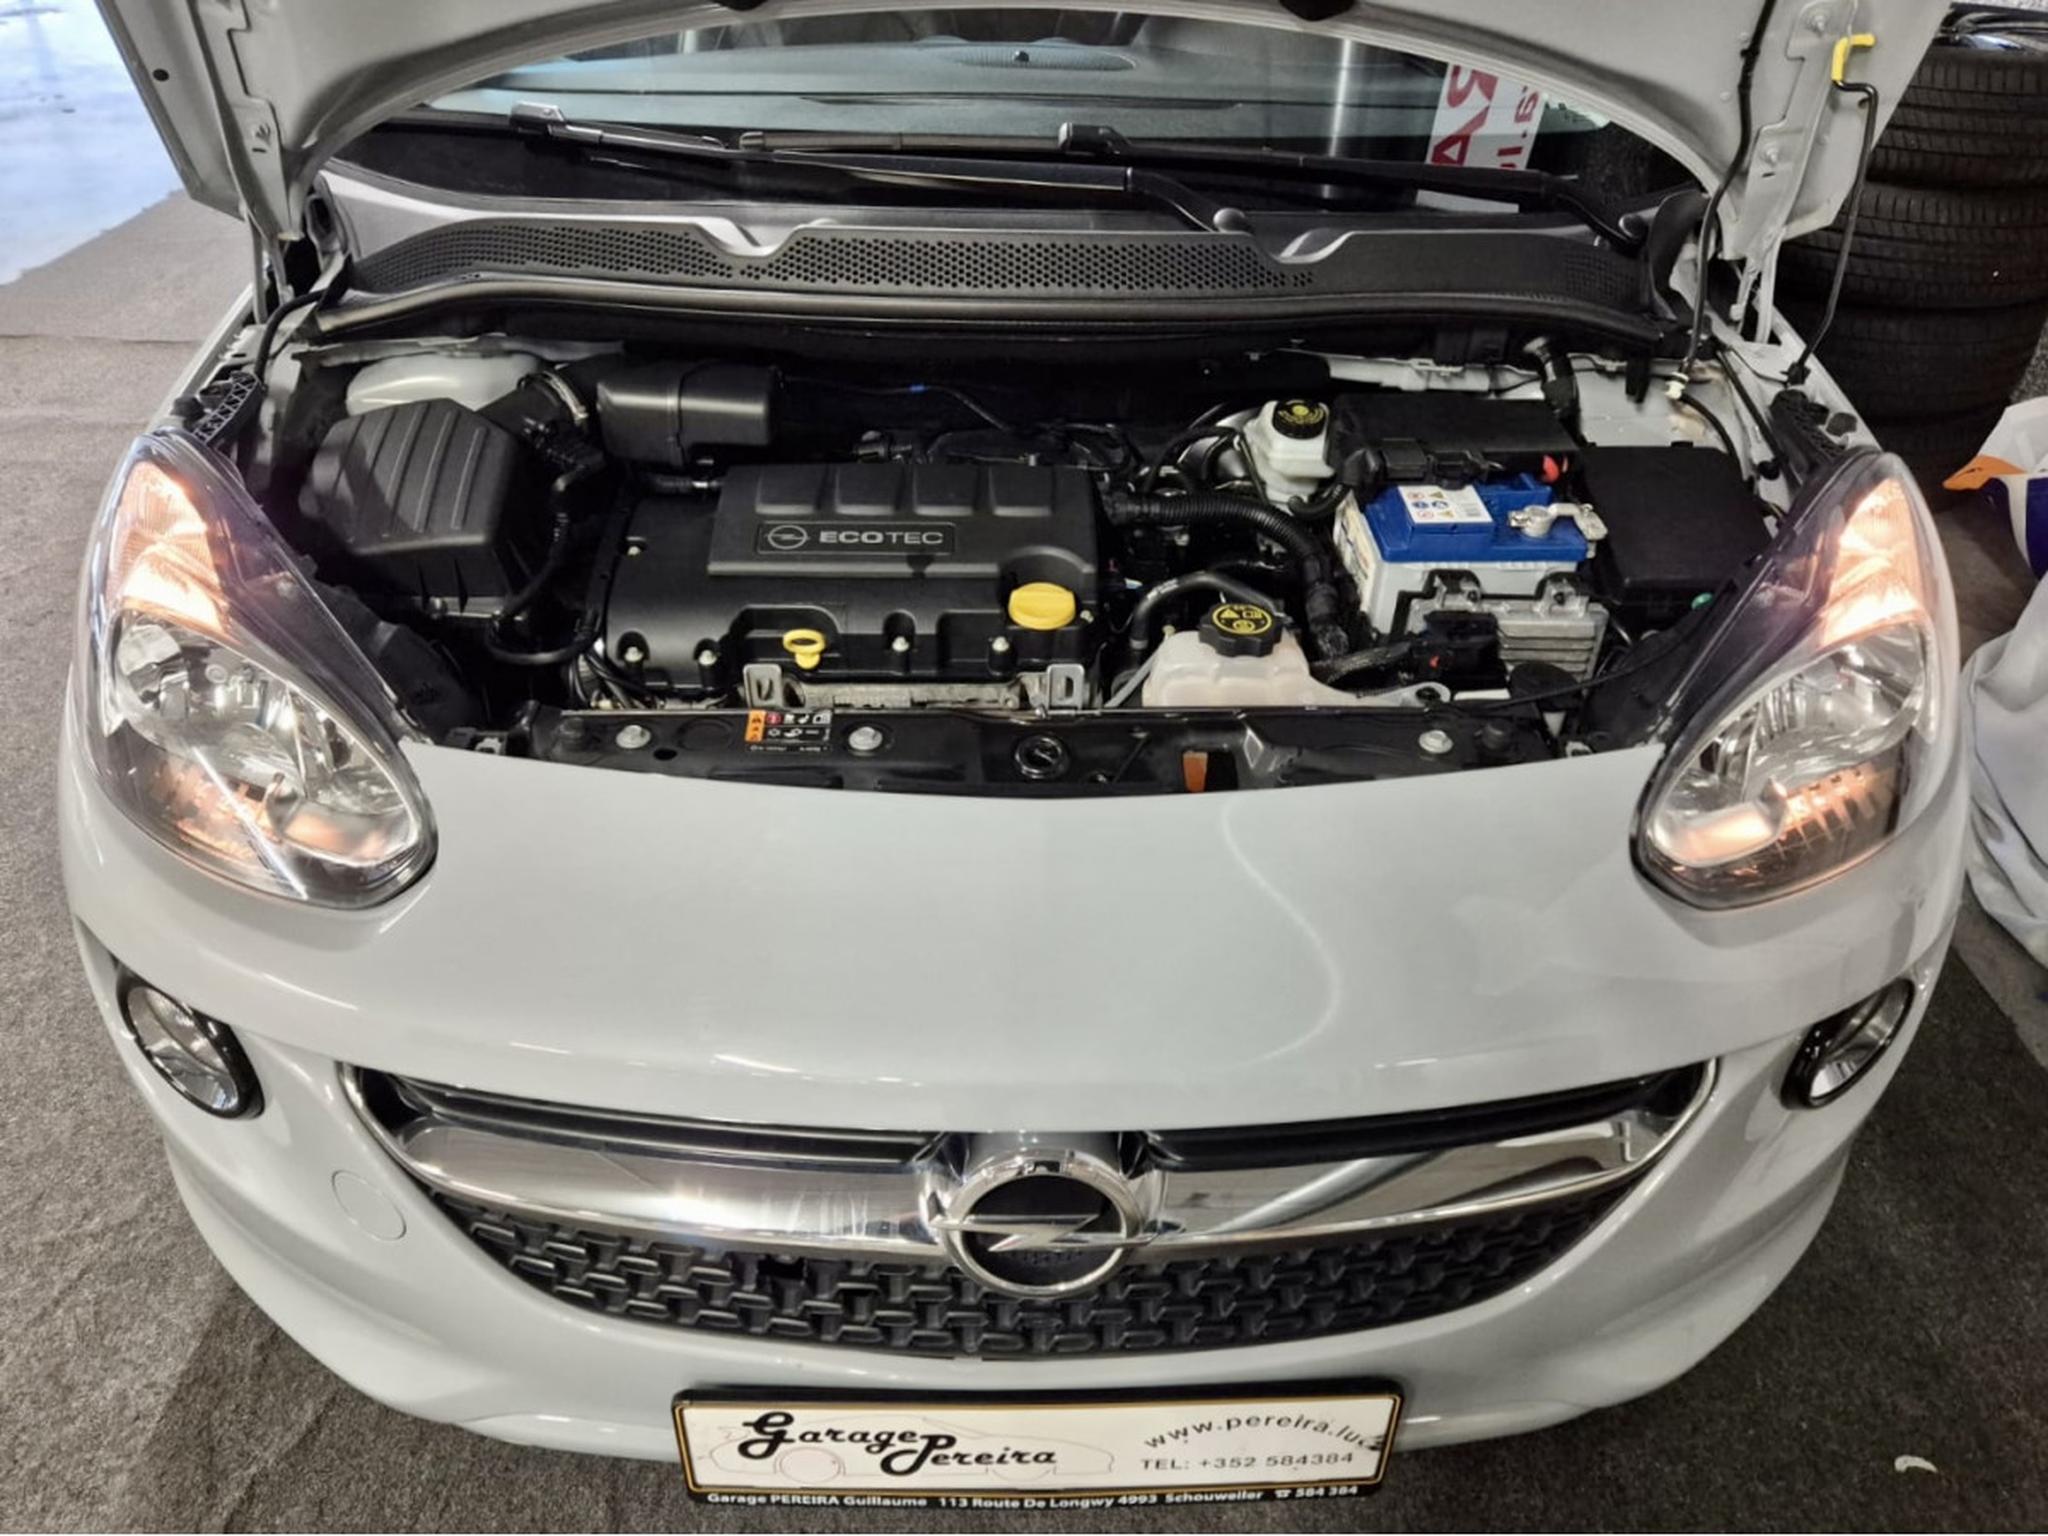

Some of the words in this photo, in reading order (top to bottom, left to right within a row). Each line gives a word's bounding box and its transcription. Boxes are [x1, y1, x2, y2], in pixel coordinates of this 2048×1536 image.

[819, 530, 944, 545] ECOTEC
[1144, 1413, 1361, 1449] www.pereira.lu
[738, 1411, 918, 1460] Garage
[880, 1433, 1057, 1476] Pereira
[1140, 1458, 1190, 1471] TEL:
[1199, 1455, 1257, 1469] +352
[1265, 1452, 1354, 1467] 584384
[707, 1493, 767, 1505] Garage
[770, 1494, 839, 1505] PEREIRA
[843, 1495, 927, 1506] Guillaume
[939, 1497, 968, 1507] 113
[972, 1498, 1020, 1508] Route
[1024, 1498, 1046, 1508] De
[1050, 1497, 1114, 1509] Longwy
[1117, 1494, 1157, 1506] 4993
[1165, 1490, 1264, 1504] Schouweiler
[1295, 1487, 1325, 1498] 584
